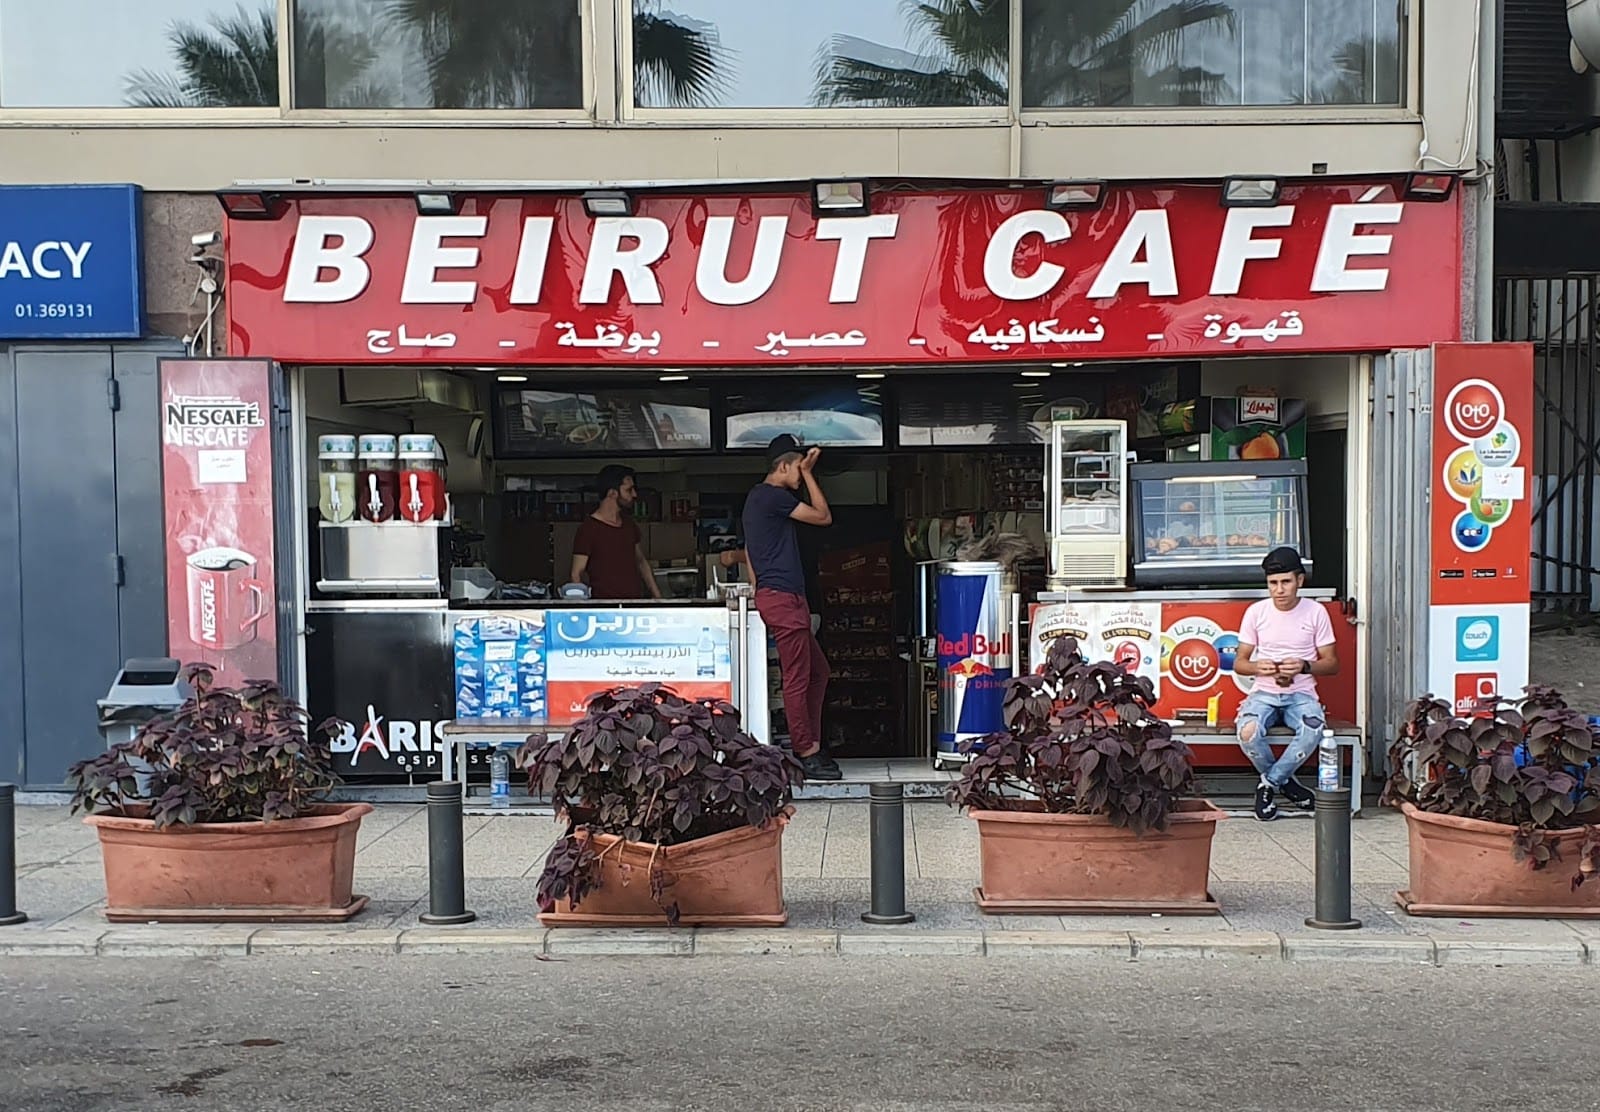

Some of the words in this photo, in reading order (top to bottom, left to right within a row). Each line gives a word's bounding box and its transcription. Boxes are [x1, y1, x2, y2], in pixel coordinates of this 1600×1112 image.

[0, 241, 92, 279] ACY
[283, 213, 899, 305] BEIRUT
[984, 186, 1404, 301] CAFÉ
[15, 303, 93, 318] 01.369131
[366, 324, 457, 354] صاج
[555, 321, 662, 355] بوظة
[754, 328, 867, 356] عصير
[967, 316, 1106, 351] نسكافيه
[1203, 310, 1304, 344] قهوة
[1246, 400, 1276, 415] Libby's
[937, 632, 969, 656] Red
[972, 632, 1011, 656] Bull
[1465, 631, 1488, 640] touch
